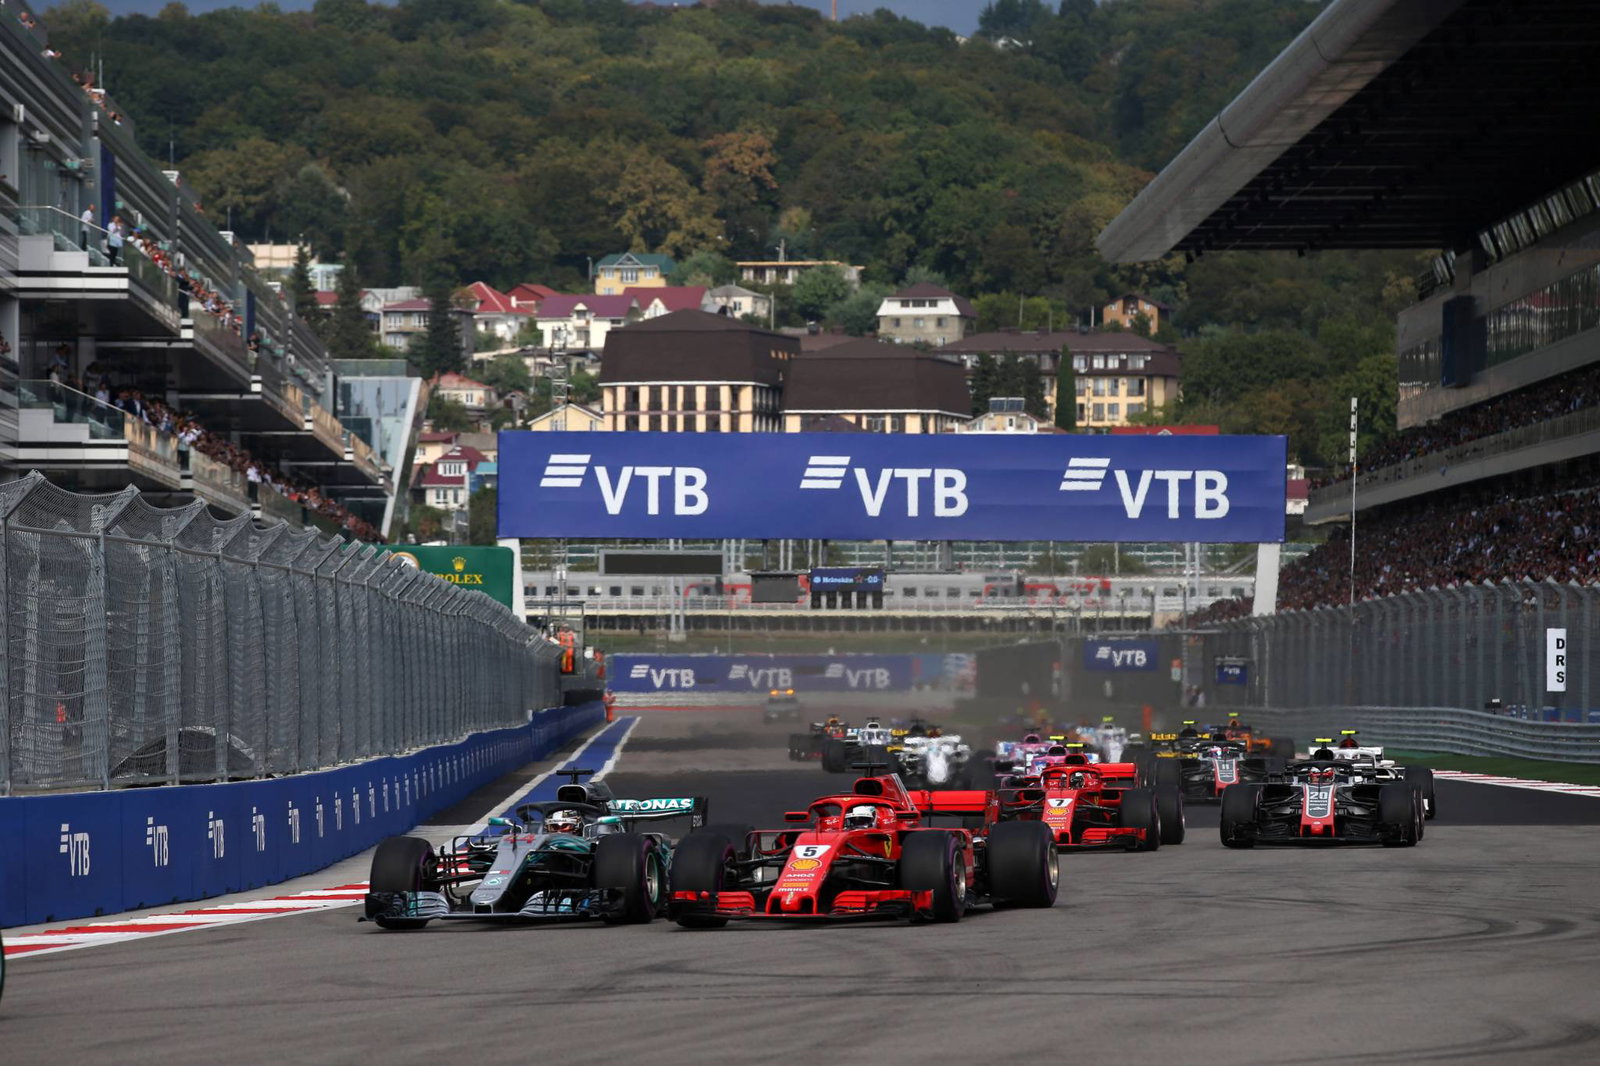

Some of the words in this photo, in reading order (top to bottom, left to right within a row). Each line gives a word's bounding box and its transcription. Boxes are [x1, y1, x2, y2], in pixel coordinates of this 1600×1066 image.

[594, 466, 709, 515] VTB
[854, 468, 969, 517] VTB
[1114, 470, 1230, 519] VTB
[1111, 650, 1147, 667] VTB
[650, 668, 696, 689] VTB
[748, 667, 793, 688] VTB
[845, 667, 890, 688] VTB
[1228, 667, 1240, 675] VTB
[1310, 791, 1328, 800] 20
[153, 825, 169, 867] VTB
[213, 819, 225, 859] VTB
[69, 832, 90, 876] VTB
[803, 846, 818, 857] 5
